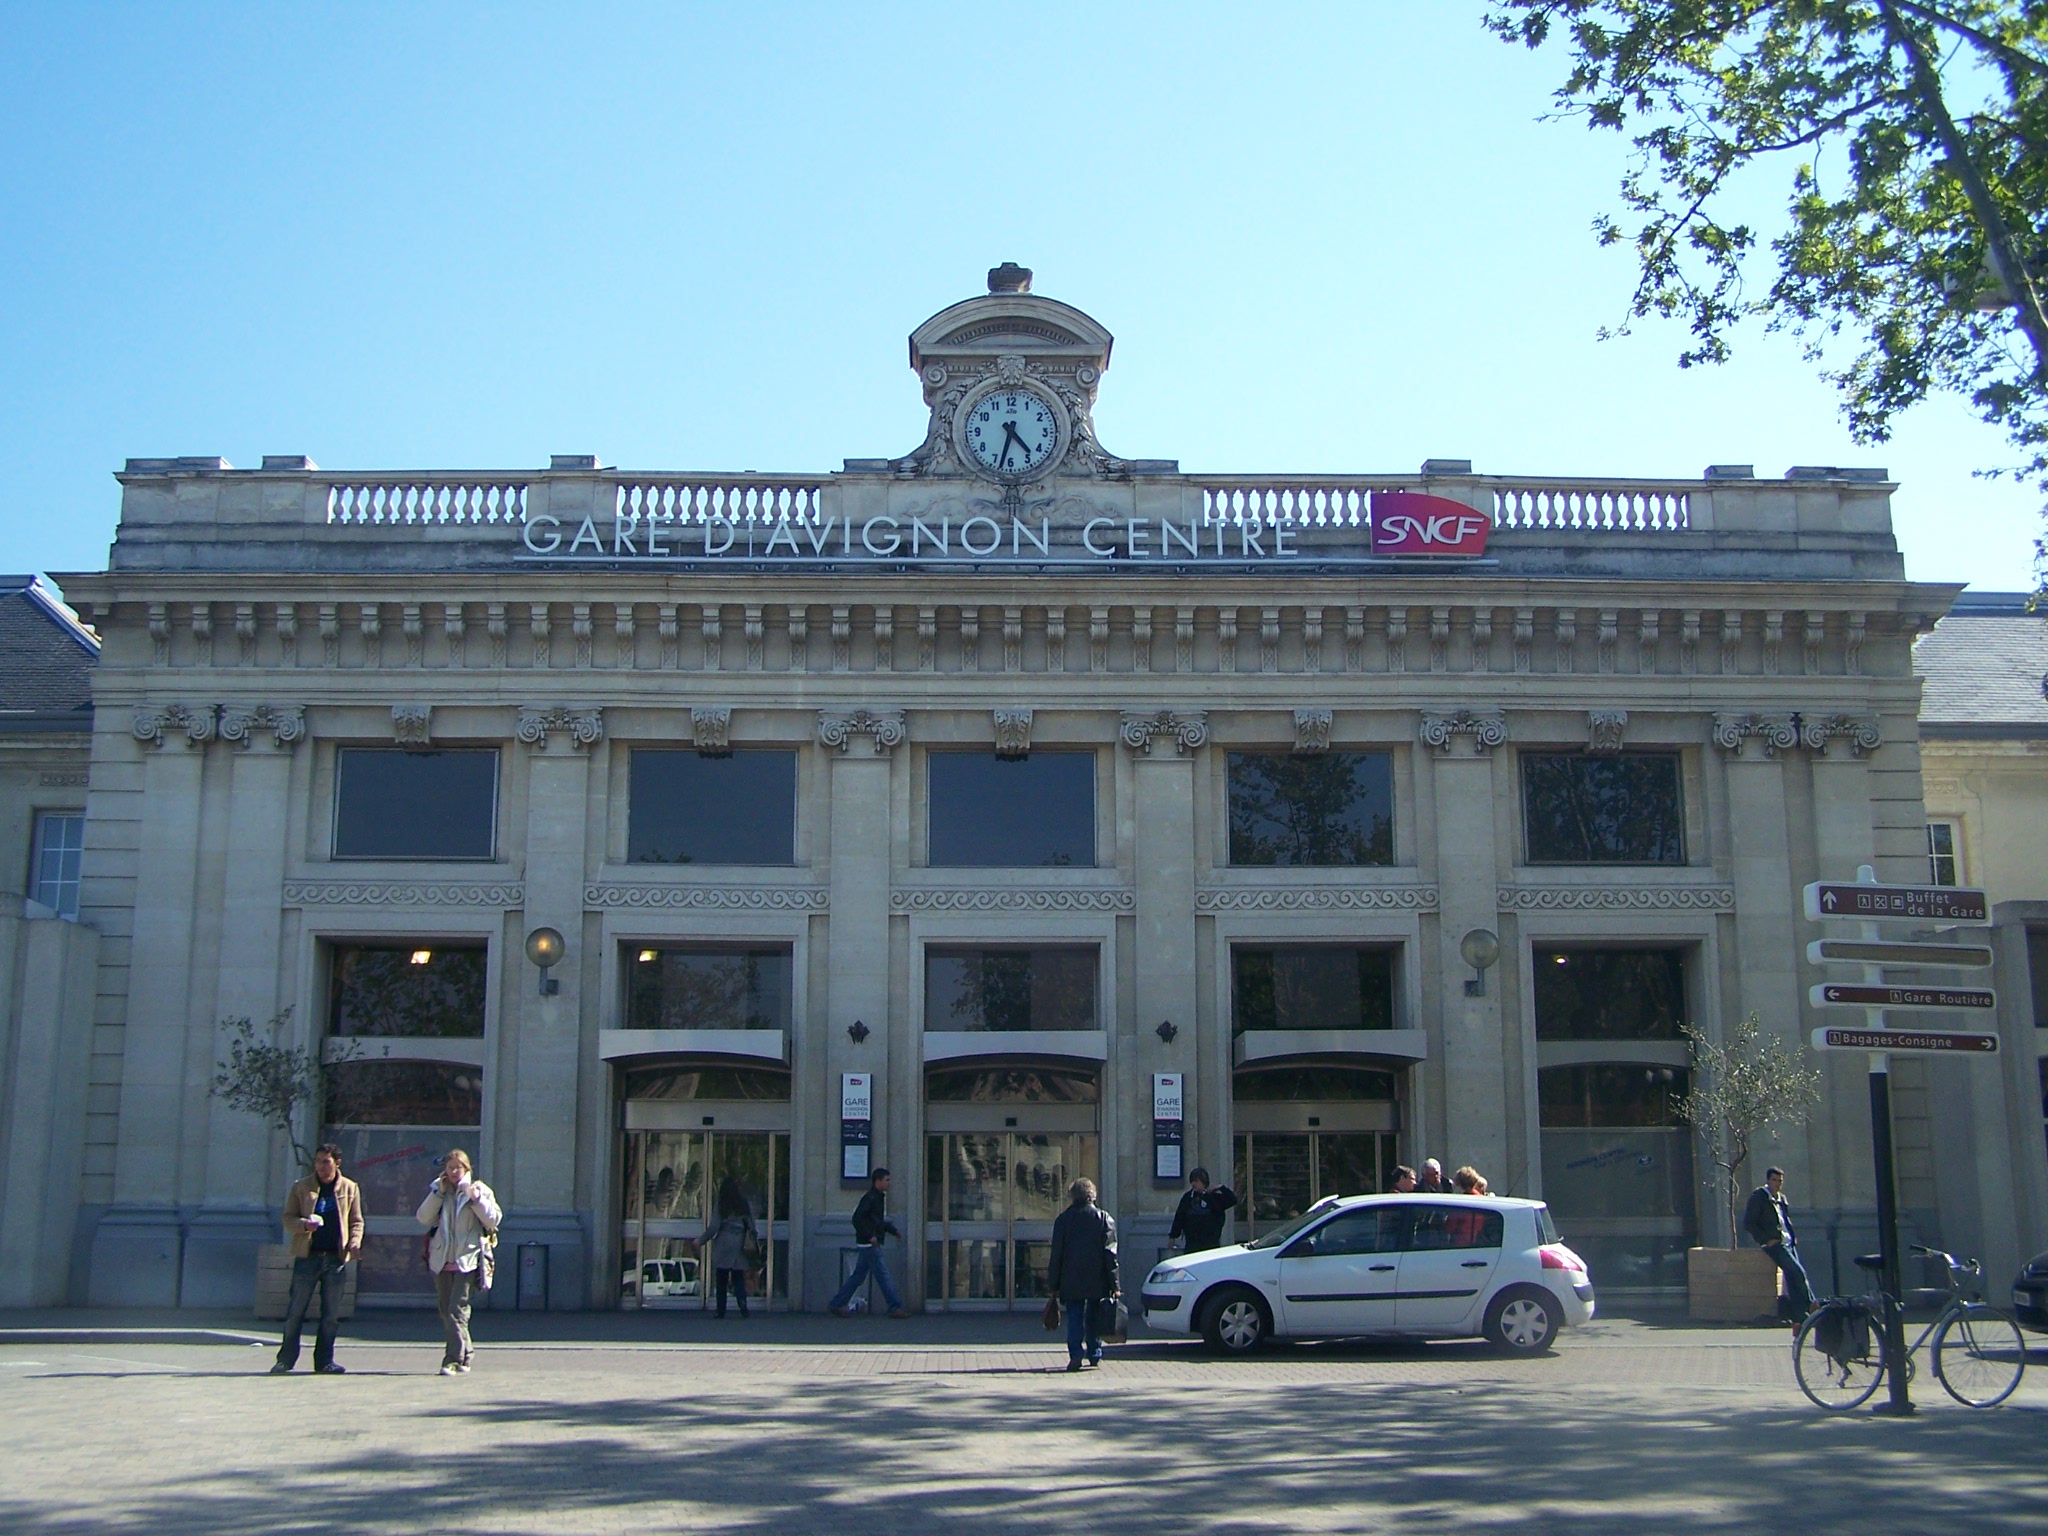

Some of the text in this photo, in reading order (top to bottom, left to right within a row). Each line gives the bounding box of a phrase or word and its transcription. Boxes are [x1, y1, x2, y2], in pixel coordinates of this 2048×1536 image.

[991, 401, 1000, 411] 11
[1006, 396, 1017, 407] 12
[1024, 401, 1029, 411] 1
[979, 412, 990, 422] 10
[1036, 412, 1043, 422] 2
[974, 427, 981, 437] 9
[1042, 428, 1048, 438] 3
[979, 442, 986, 452] 8
[1035, 443, 1043, 453] 4
[991, 454, 998, 463] 7
[1007, 457, 1014, 468] 6
[1024, 454, 1031, 464] 5
[1377, 515, 1485, 545] SNCF
[523, 514, 1299, 557] GARE D'AVIGNON CENTRE
[1906, 892, 1950, 905] Buffet
[1907, 905, 1984, 918] de la Gare
[1904, 993, 1992, 1005] Gare Routière
[1843, 1033, 1953, 1048] Bagages-Consigne
[844, 1098, 868, 1106] GARE
[1156, 1098, 1180, 1106] GARE
